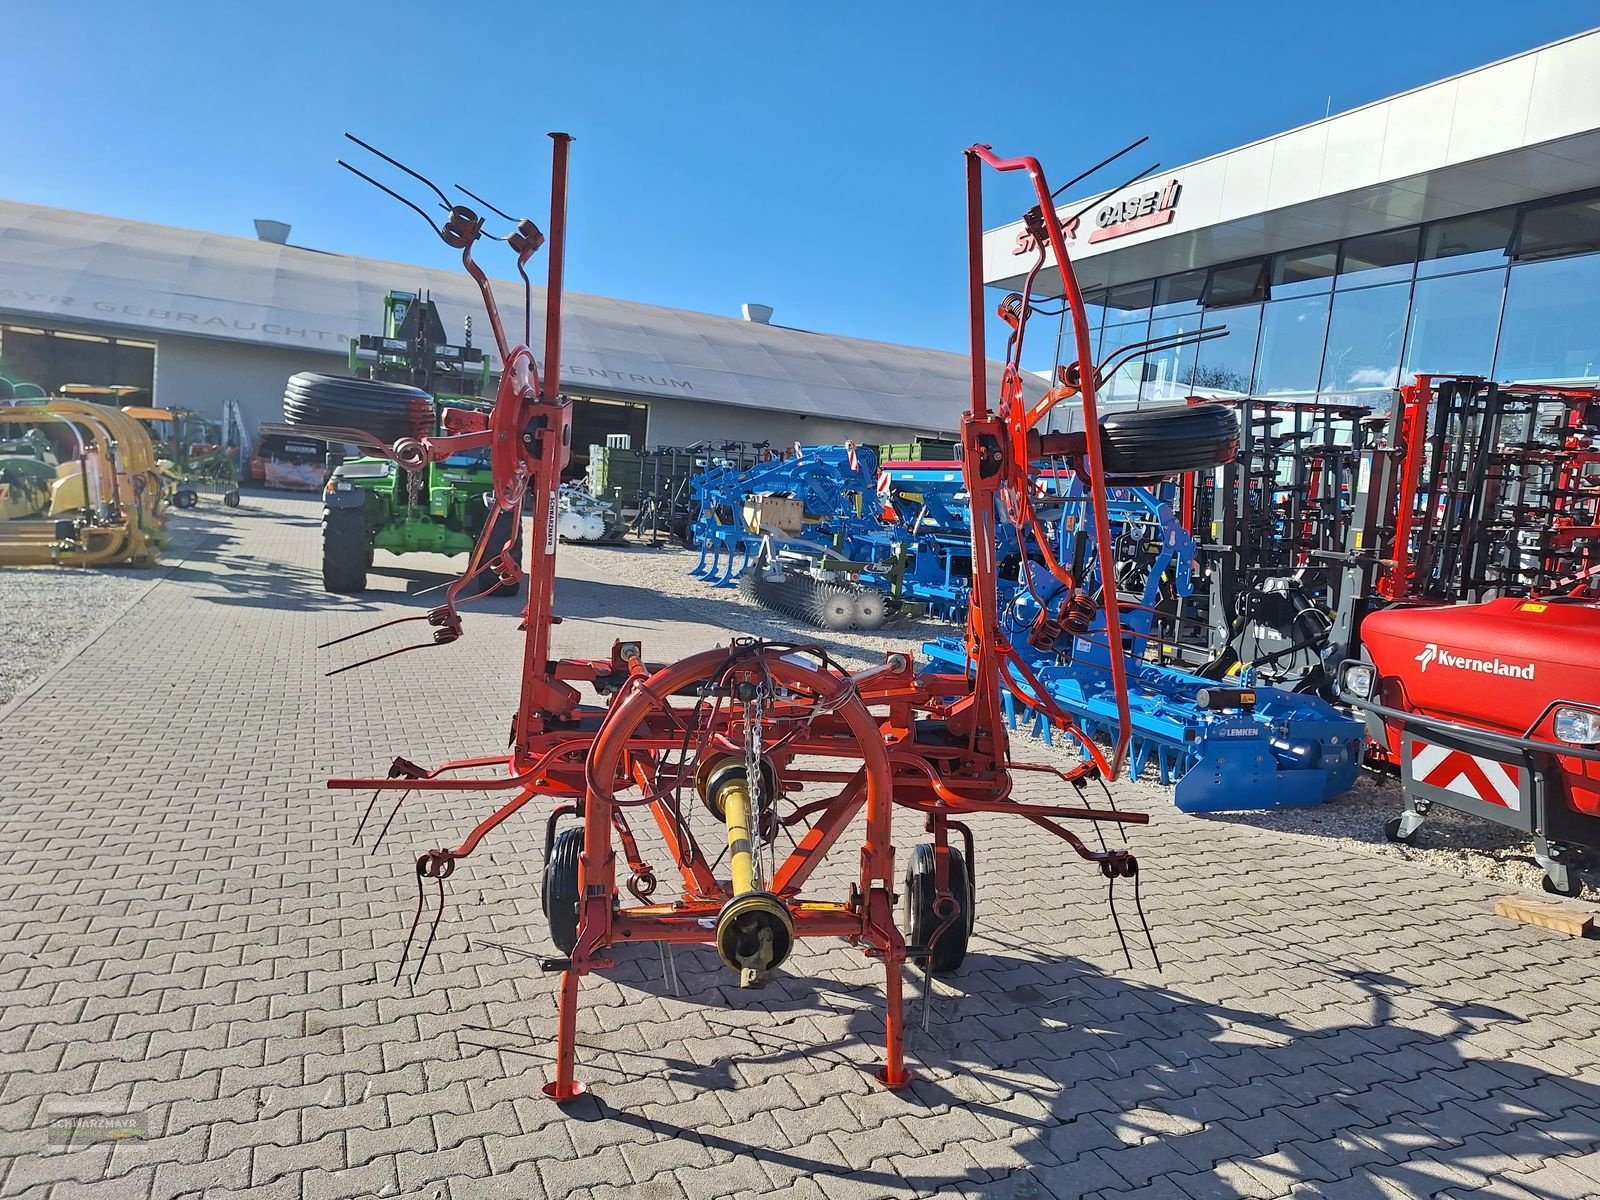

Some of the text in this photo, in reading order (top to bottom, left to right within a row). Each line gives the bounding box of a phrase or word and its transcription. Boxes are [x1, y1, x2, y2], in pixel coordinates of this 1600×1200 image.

[1096, 191, 1159, 228] CASE
[547, 497, 556, 546] SCHWARZMAYR
[1438, 649, 1535, 680] Kverneland
[1226, 728, 1259, 737] LEMKEN
